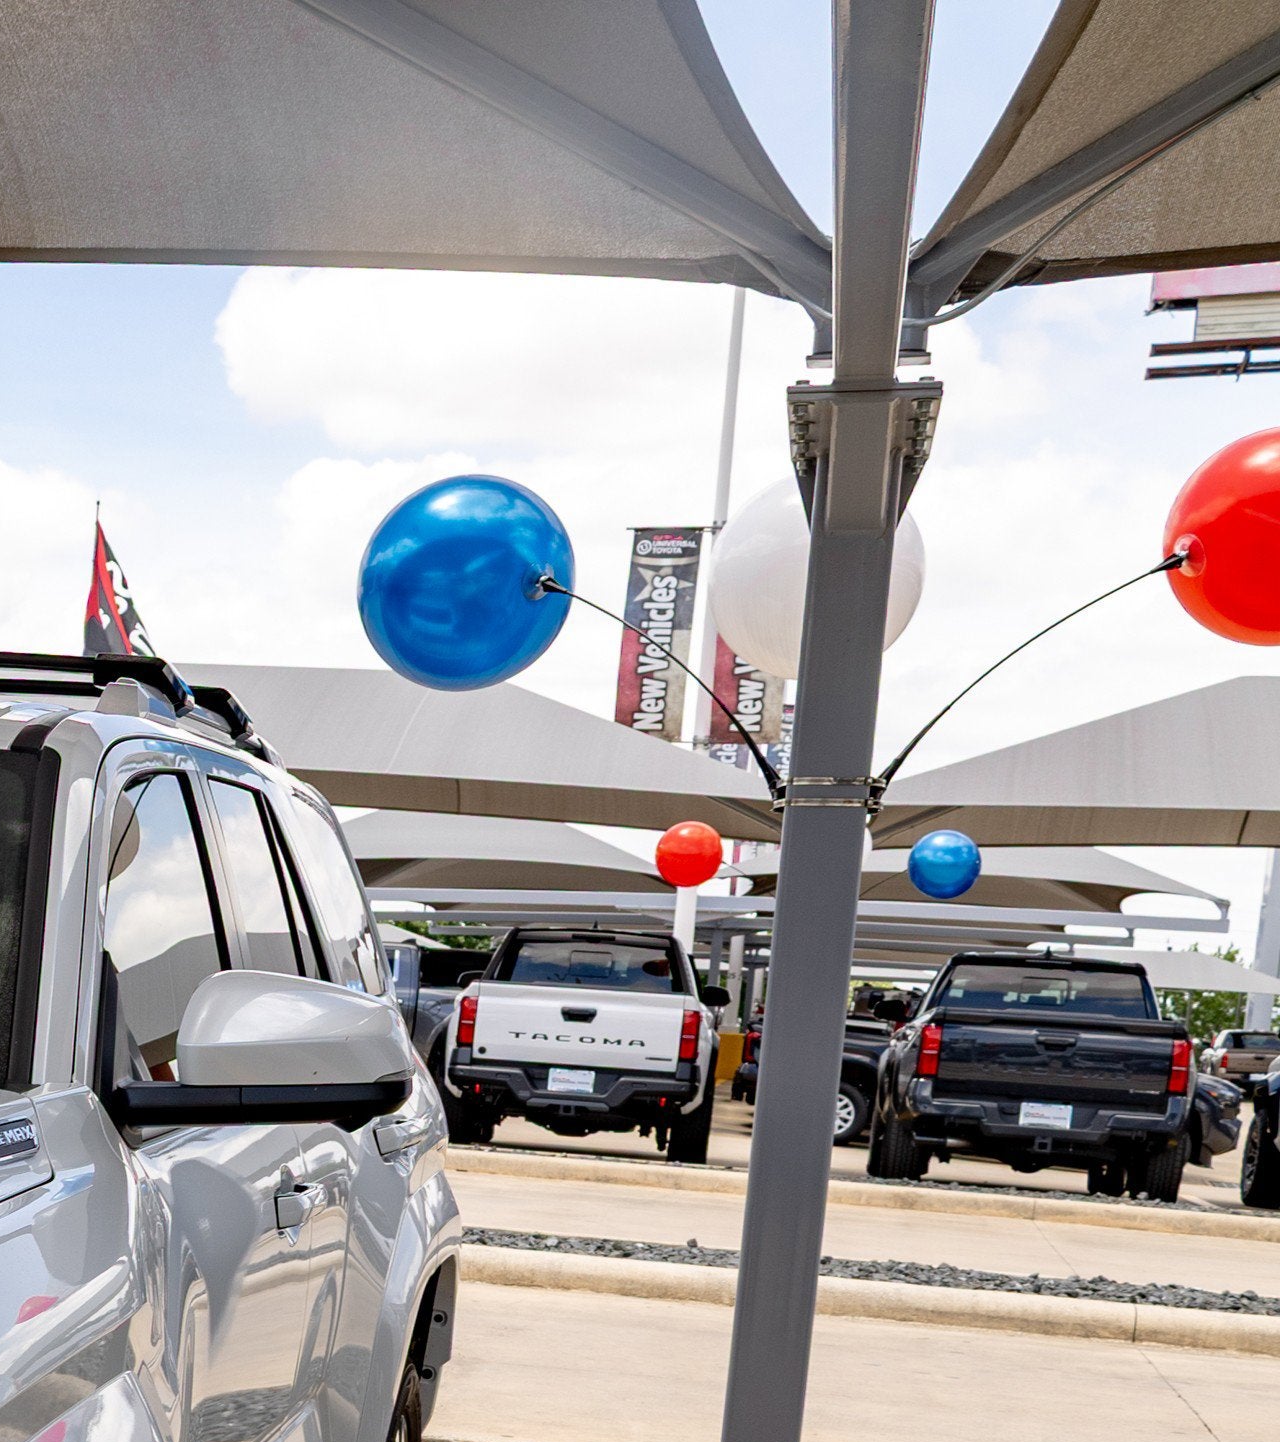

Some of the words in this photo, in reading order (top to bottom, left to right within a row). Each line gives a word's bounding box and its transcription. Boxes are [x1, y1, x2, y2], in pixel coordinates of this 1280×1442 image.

[652, 539, 697, 548] UNIVERSAL
[632, 678, 668, 731] New
[729, 679, 766, 732] New
[508, 1031, 645, 1047] TACOMA
[3, 1125, 33, 1145] MAX
